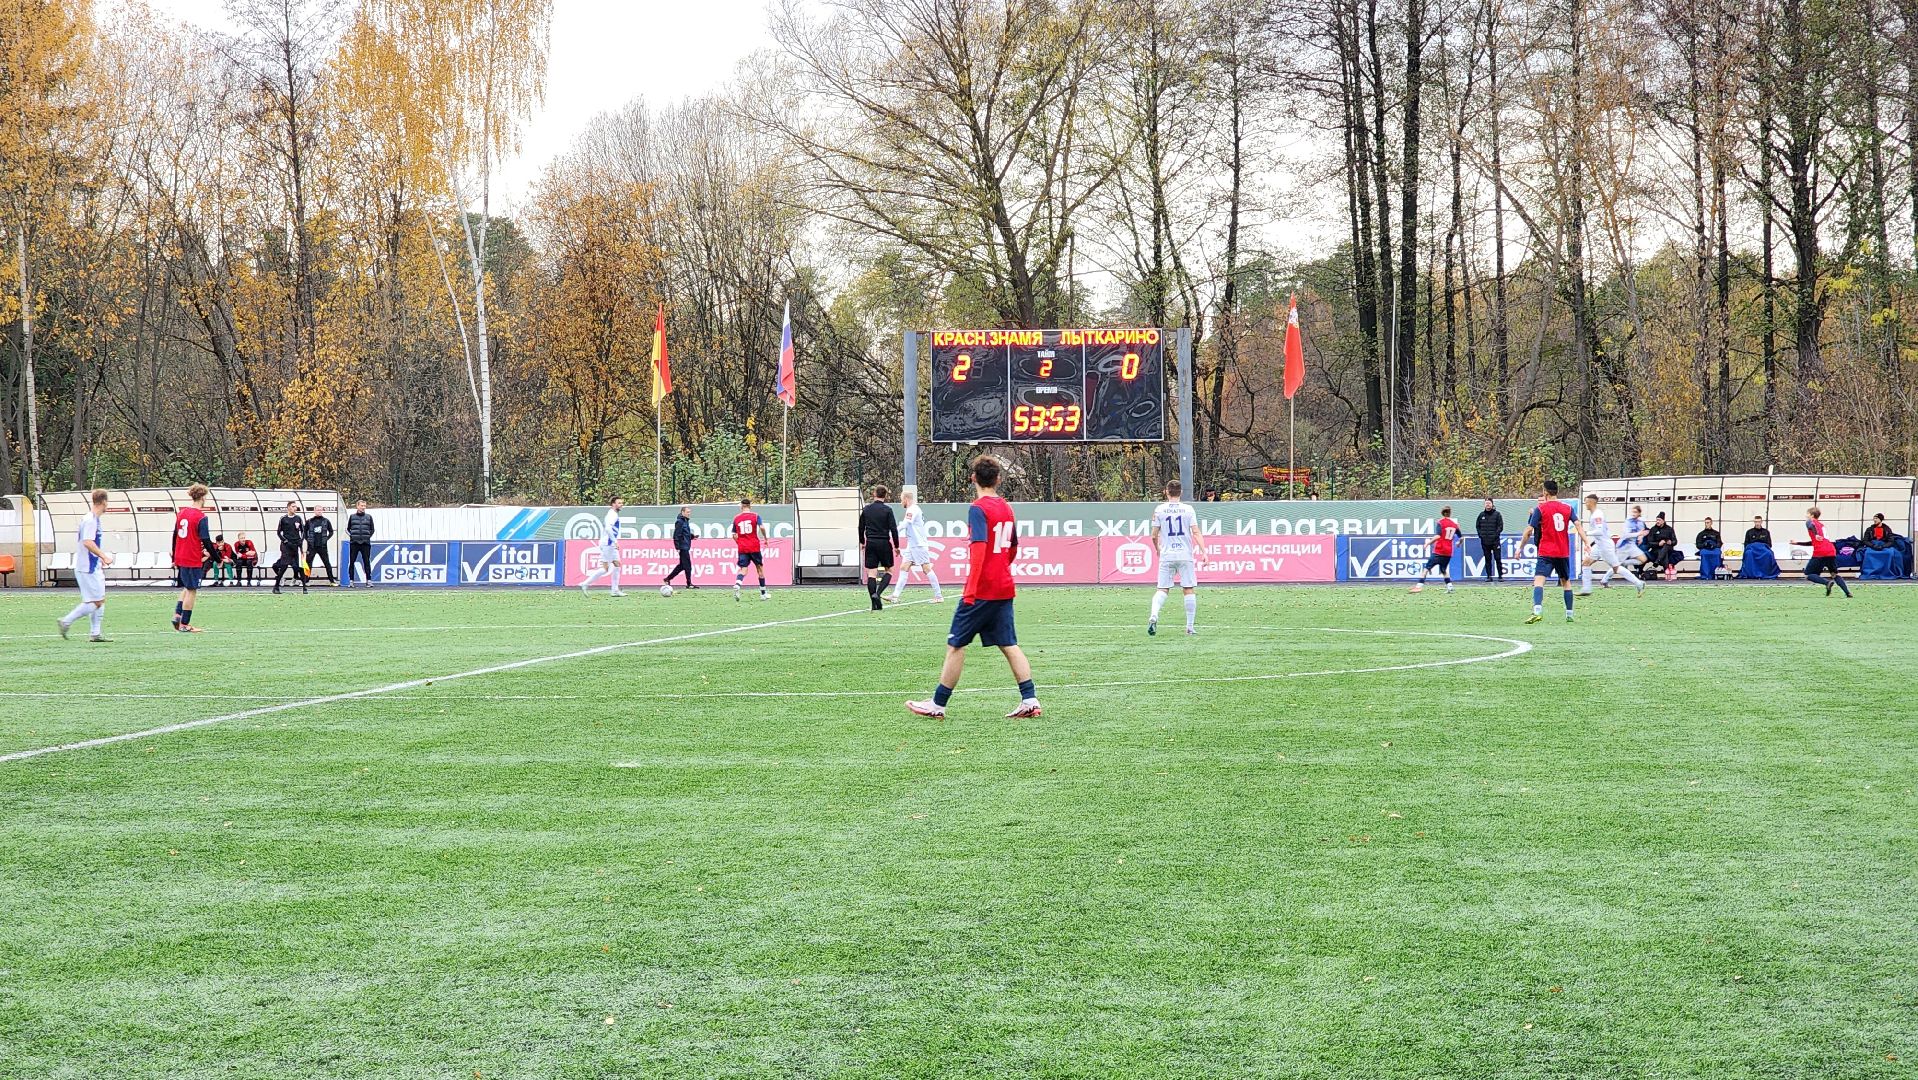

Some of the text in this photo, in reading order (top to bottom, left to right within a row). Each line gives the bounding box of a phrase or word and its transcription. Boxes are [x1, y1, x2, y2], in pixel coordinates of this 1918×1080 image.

[934, 330, 1159, 346] КРАСН.ЗНАМЯ ЛЫТКАРИНО
[1037, 348, 1055, 358] ТАЙМ
[952, 354, 971, 381] 2
[1039, 359, 1053, 377] 2
[1121, 353, 1140, 380] 0
[1036, 386, 1058, 394] ВРЕМЯ
[1014, 405, 1081, 432] 53:53
[178, 518, 188, 538] 3
[738, 520, 753, 535] 15
[1165, 515, 1185, 536] 11
[1237, 518, 1257, 535] и
[1270, 518, 1458, 536] развити
[1553, 512, 1565, 532] 8
[993, 521, 1013, 553] 14
[1225, 544, 1322, 556] ТРАНСЛЯЦИИ
[385, 566, 444, 580] SPORT
[492, 566, 551, 580] SPORT
[622, 564, 643, 575] на
[1260, 558, 1284, 571] TV
